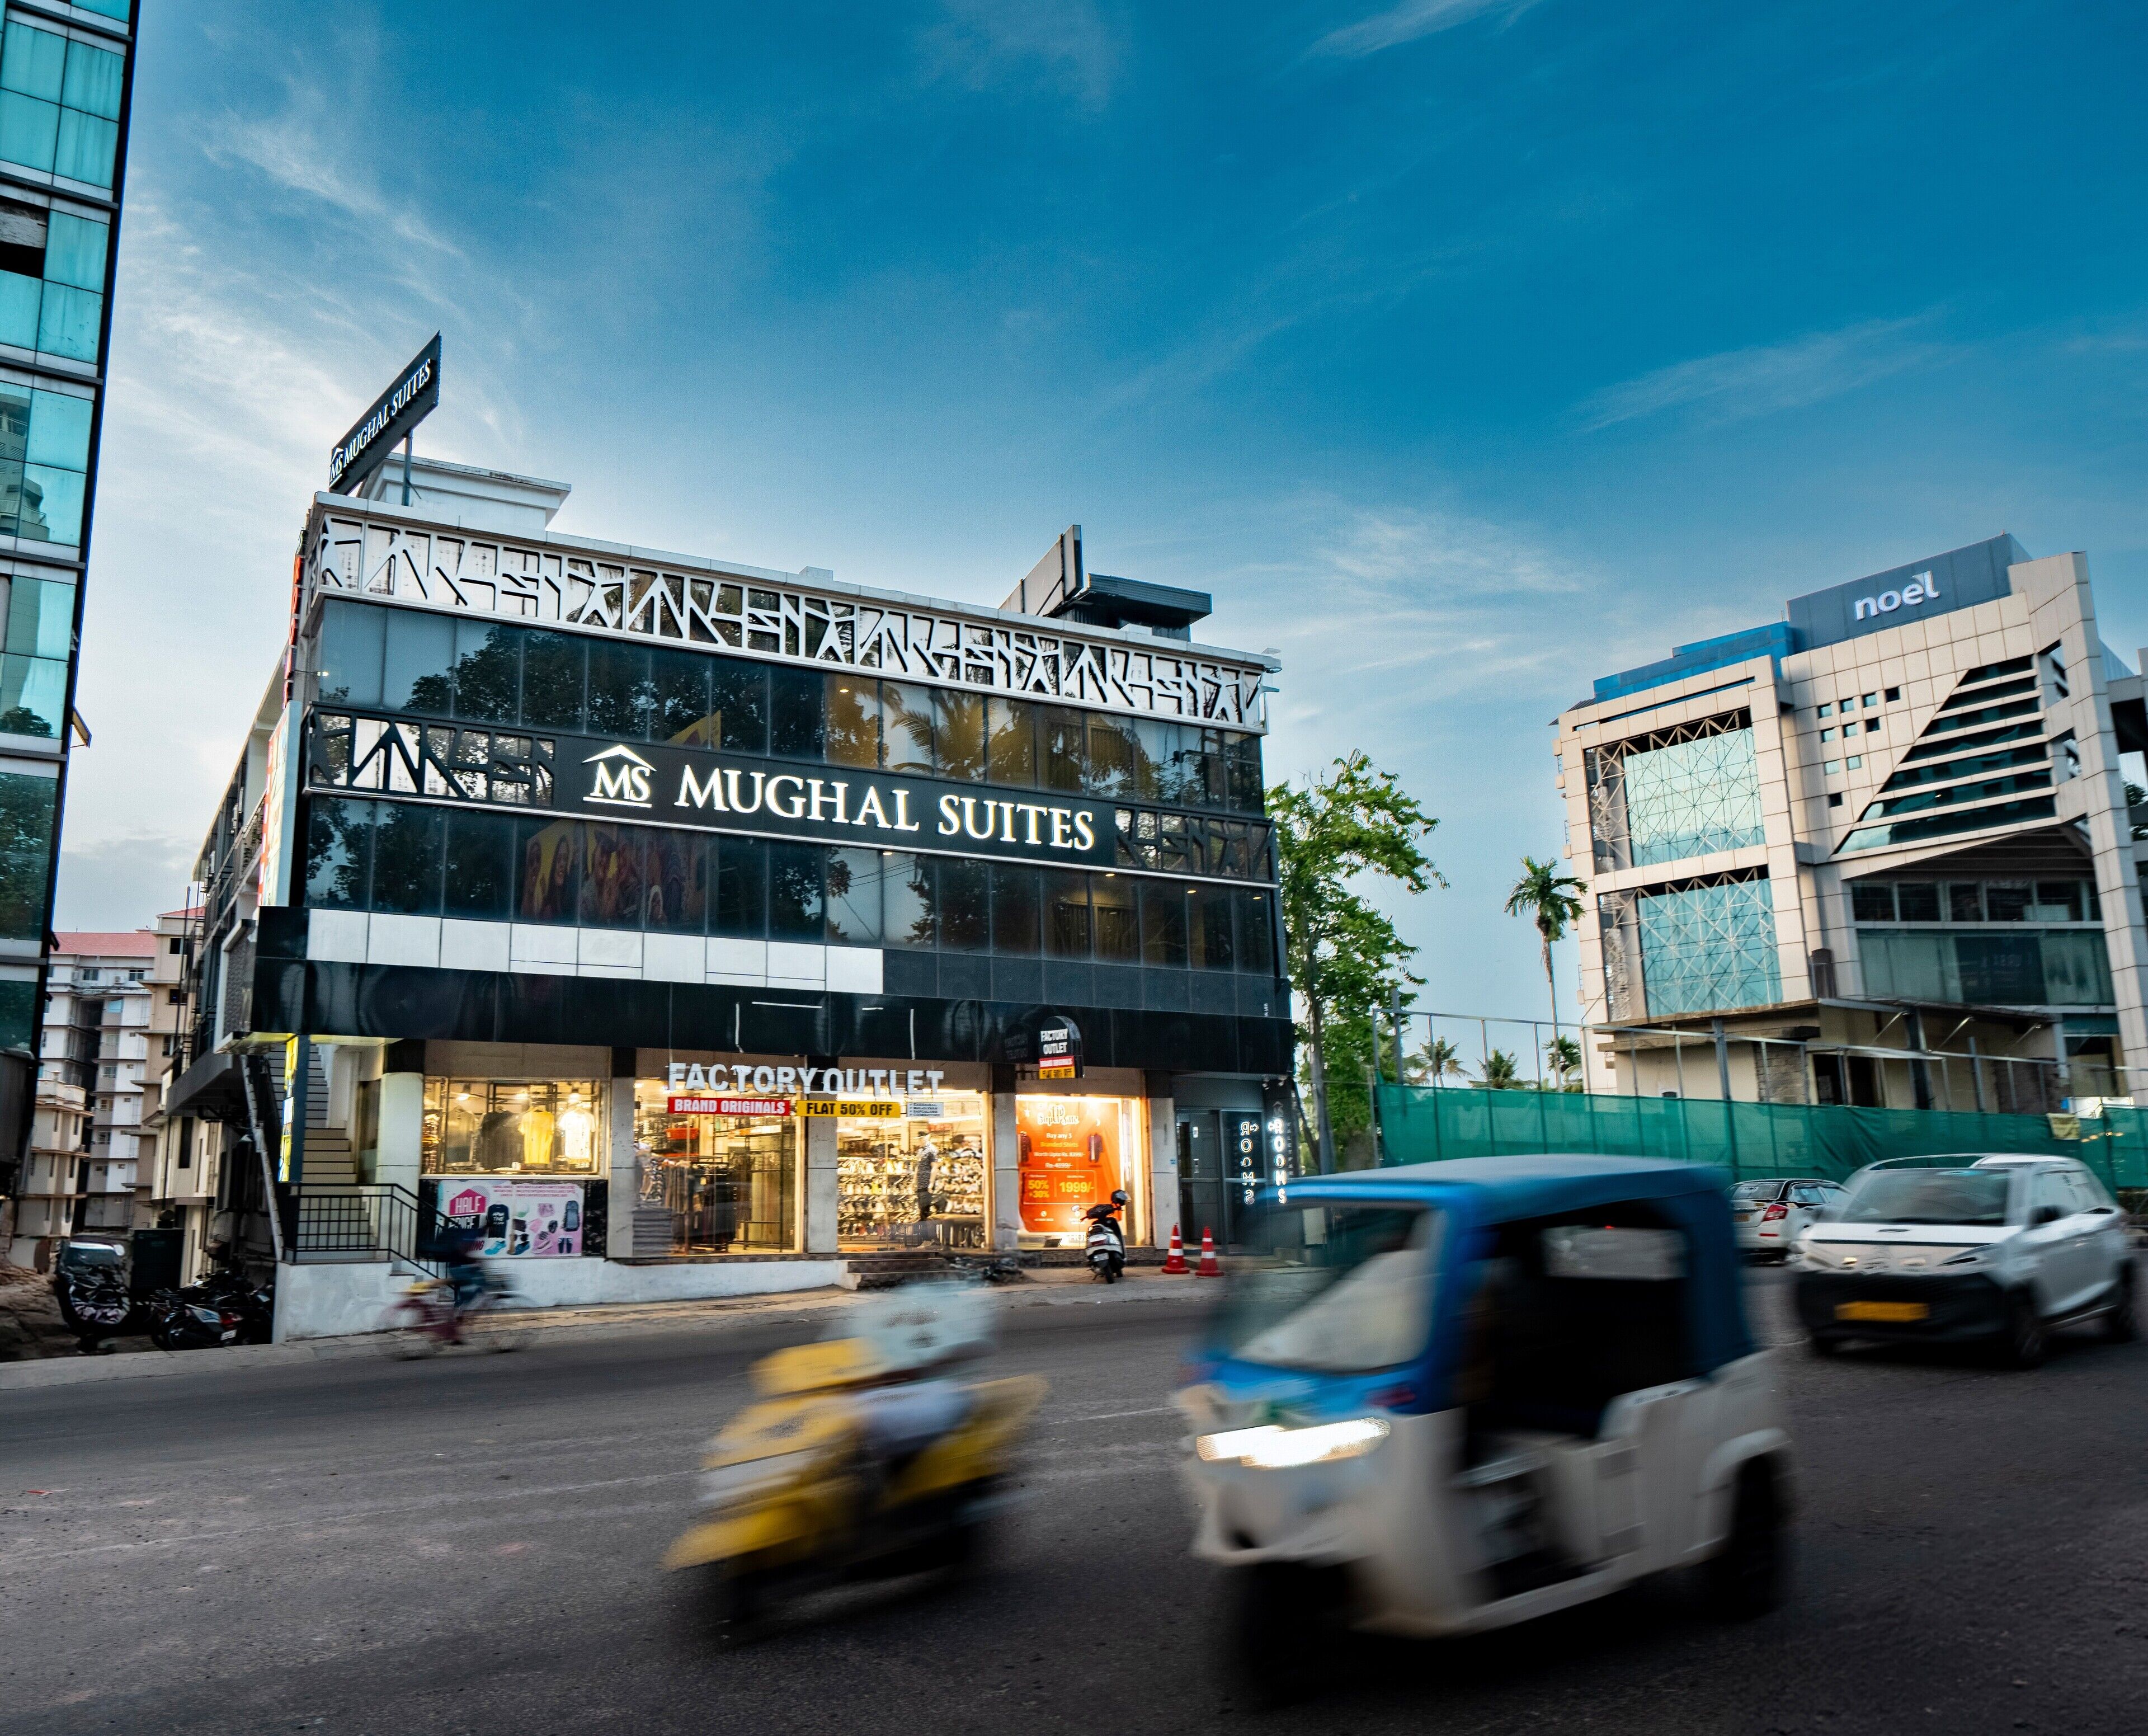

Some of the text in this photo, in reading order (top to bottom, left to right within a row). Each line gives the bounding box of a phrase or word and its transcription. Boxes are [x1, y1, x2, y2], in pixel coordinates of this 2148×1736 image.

[329, 358, 431, 481] MS MUGHAL SUITES
[1854, 570, 1940, 621] noel
[589, 761, 1094, 850] MS MUGHAL SUITES
[1040, 1028, 1068, 1042] FACTORY
[1043, 1042, 1067, 1055] OUTLET
[668, 1062, 944, 1097] FACTORY OUTLET
[675, 1099, 785, 1114] BRAND ORIGINALS
[806, 1103, 893, 1116] FLAT 50% OFF
[1273, 1118, 1287, 1205] ROOMS
[1028, 1180, 1049, 1189] 50%
[1059, 1182, 1095, 1193] 1999/-
[455, 1196, 482, 1214] HALF
